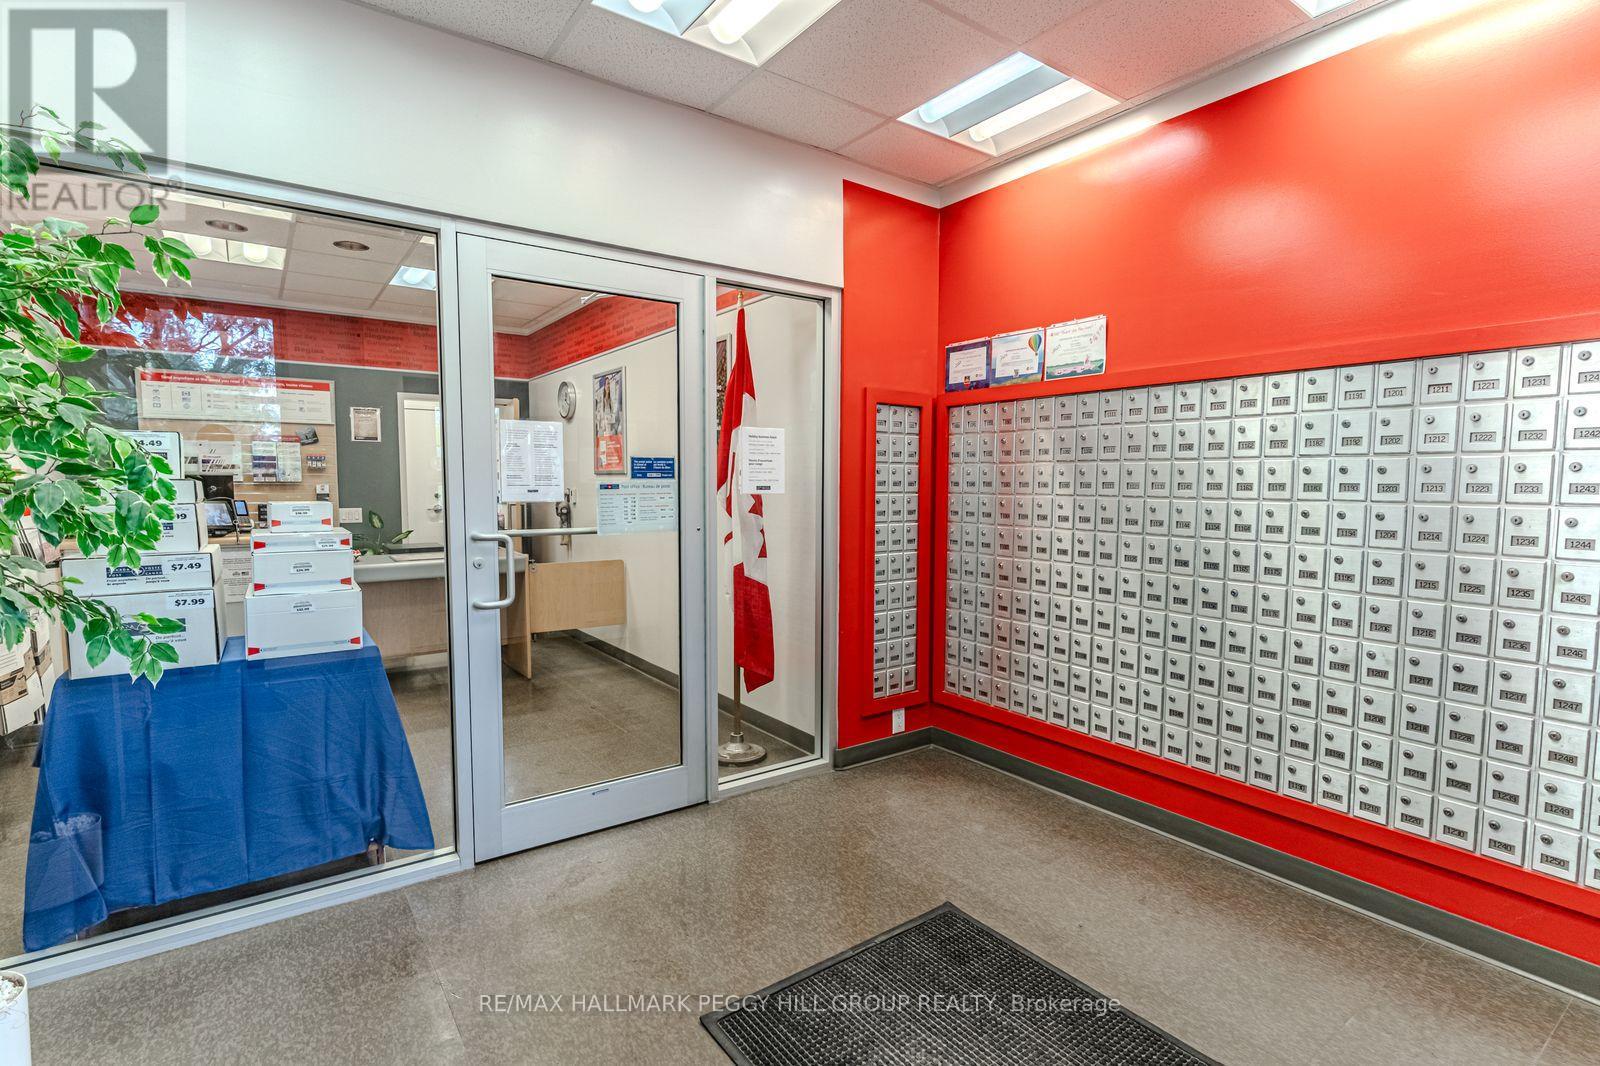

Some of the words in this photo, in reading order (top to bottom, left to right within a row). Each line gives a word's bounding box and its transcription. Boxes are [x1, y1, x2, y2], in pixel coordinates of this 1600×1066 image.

[1584, 374, 1600, 383] 124
[1433, 385, 1448, 393] 1211
[171, 562, 202, 571] $7.49
[174, 598, 205, 607] $7.99
[1566, 594, 1586, 602] 1245
[1461, 635, 1478, 643] 1226
[1508, 641, 1526, 649] 1236
[1563, 648, 1582, 657] 1246
[1505, 692, 1522, 700] 1237
[1558, 701, 1577, 710] 1247
[1501, 742, 1519, 751] 1238
[1554, 754, 1573, 763] 1248
[1550, 805, 1569, 815] 1249
[1405, 815, 1420, 824] 1220
[1447, 828, 1464, 837] 1230
[1493, 842, 1511, 851] 1240
[1545, 856, 1565, 866] 1250
